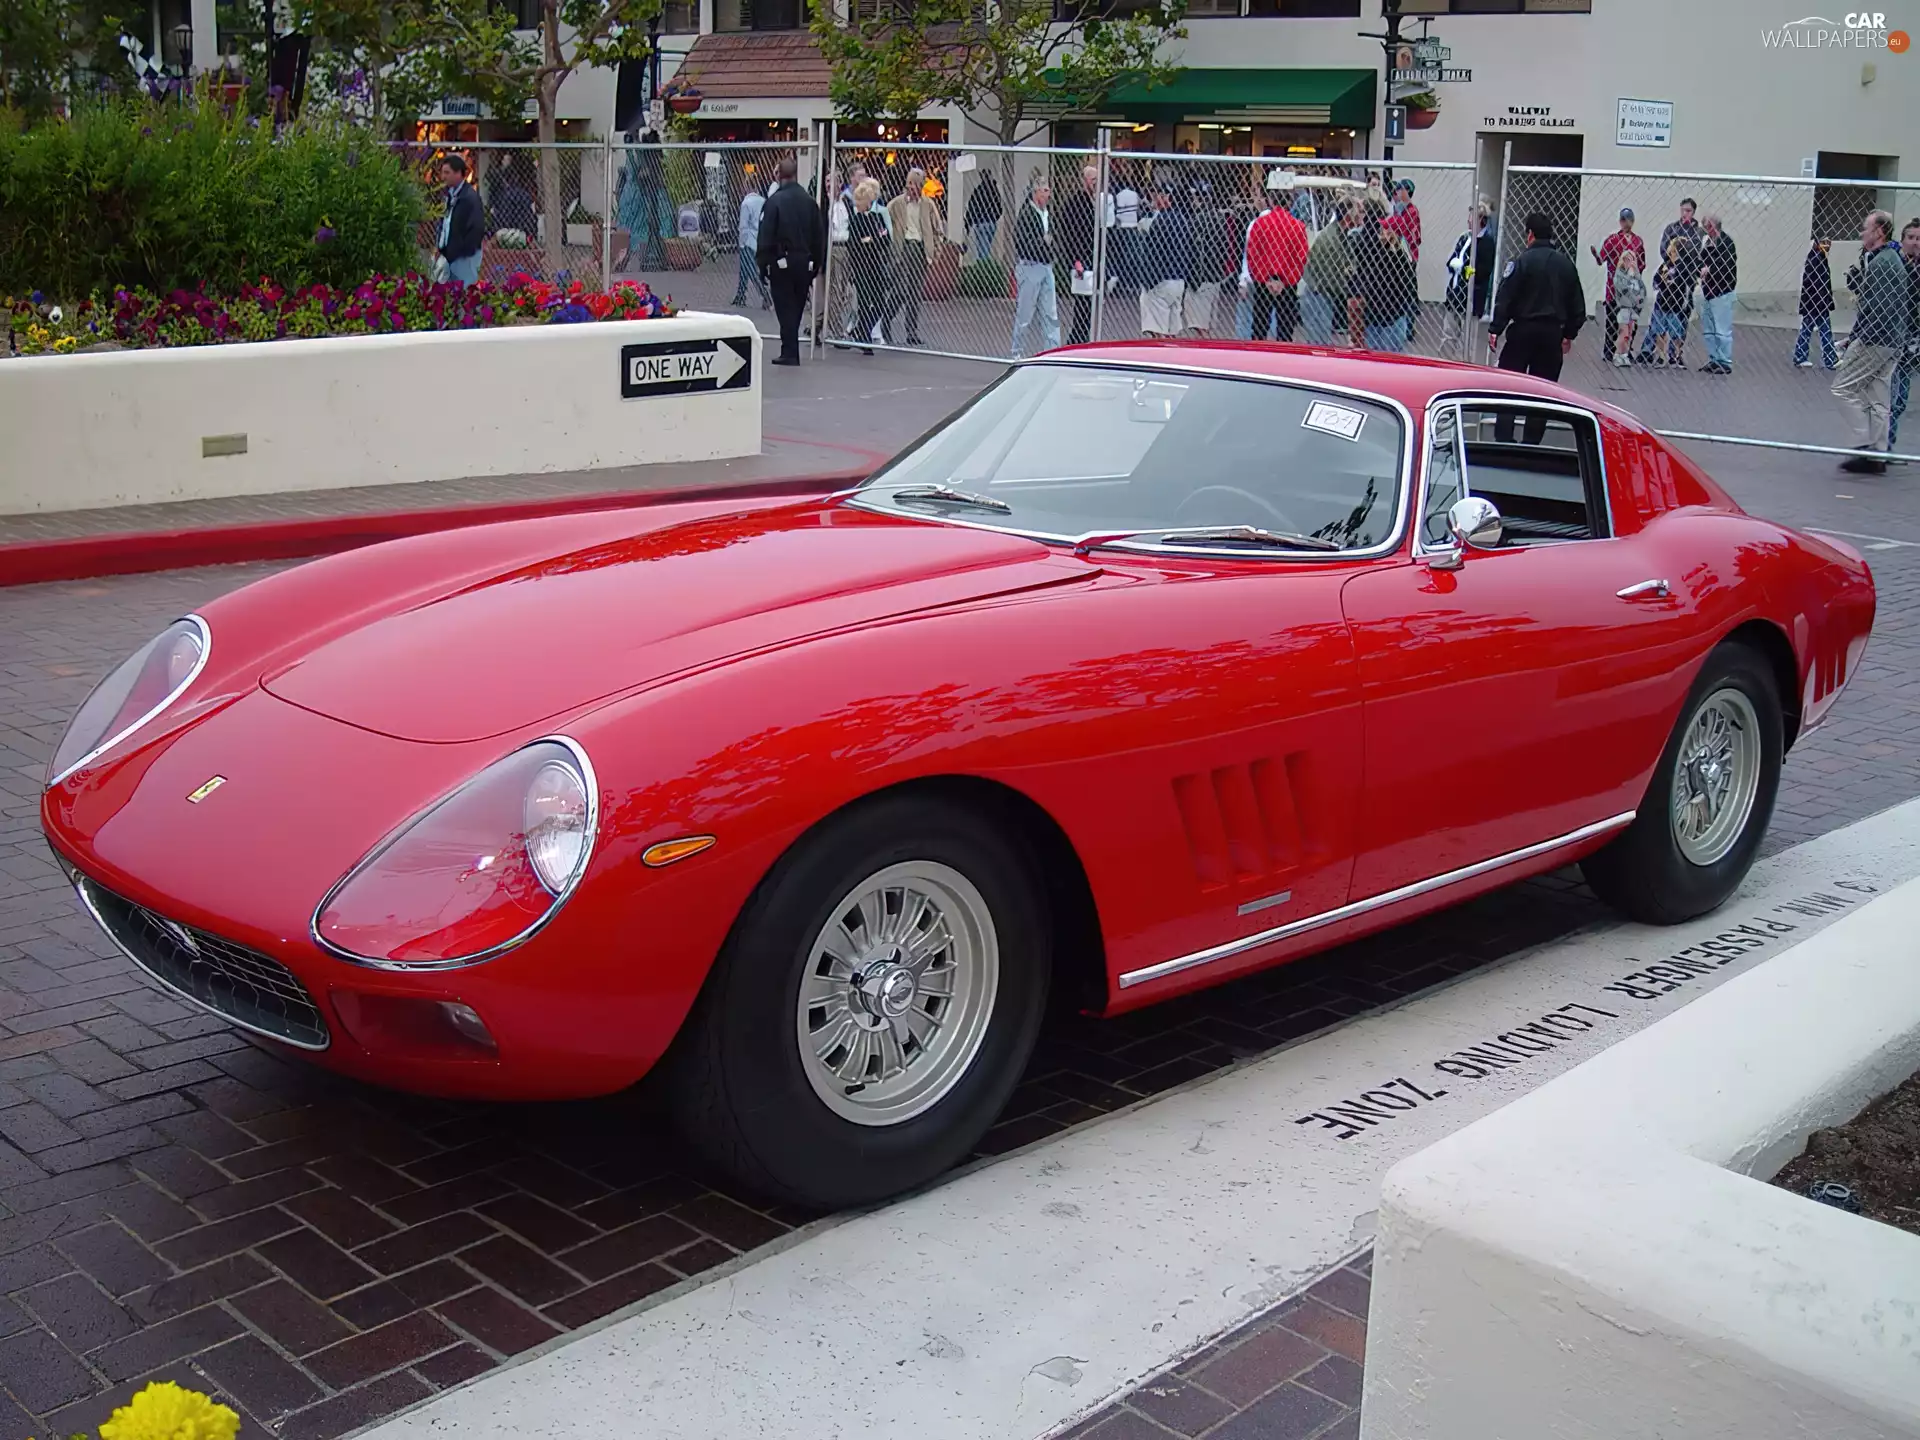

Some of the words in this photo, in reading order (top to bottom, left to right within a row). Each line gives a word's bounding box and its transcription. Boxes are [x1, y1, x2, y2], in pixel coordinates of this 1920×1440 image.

[1483, 117, 1496, 127] TO
[635, 358, 671, 381] ONE
[678, 354, 714, 377] WAY
[1602, 916, 1800, 1000] PASSENGER
[1433, 1002, 1620, 1080] LOADING
[1294, 1077, 1450, 1140] ZONE
